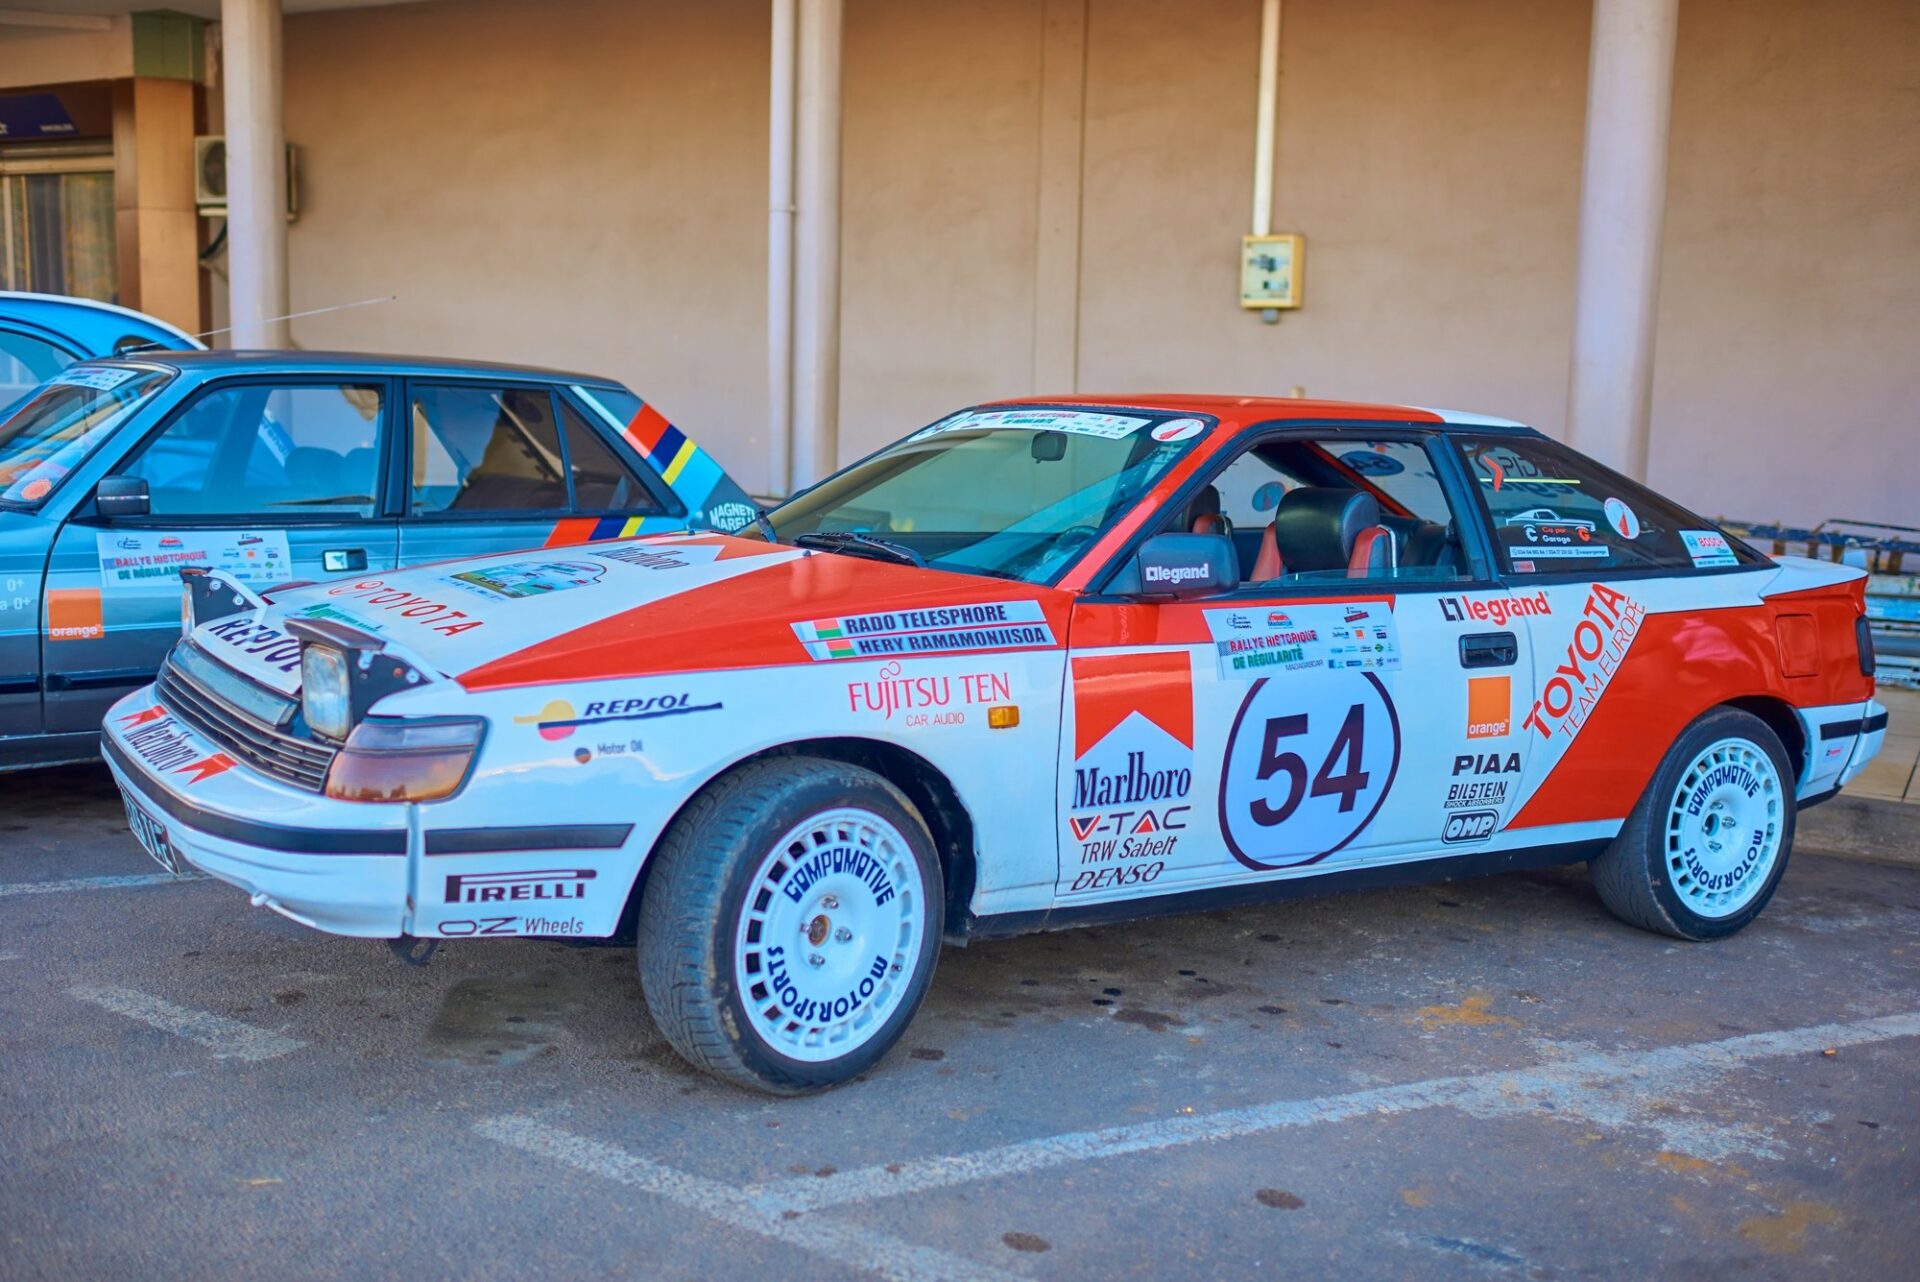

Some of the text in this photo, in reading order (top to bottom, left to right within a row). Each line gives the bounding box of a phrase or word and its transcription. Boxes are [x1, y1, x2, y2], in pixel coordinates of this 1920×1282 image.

[709, 503, 756, 525] MAGNETI
[1542, 535, 1571, 544] Garage
[114, 556, 151, 568] RALLYE
[117, 564, 179, 580] DE RÉGULAR
[1158, 563, 1209, 584] legrand
[353, 588, 484, 636] TOYOTA
[844, 605, 1008, 634] RADO TELESPHORE
[1461, 591, 1553, 626] legrand
[52, 626, 98, 638] orange
[857, 627, 1048, 654] HERY RAMAMONJISOA
[1230, 637, 1265, 653] RALLYE
[1265, 629, 1319, 648] HISTORIQUE
[1233, 643, 1304, 669] DE RÉGULARITÉ
[1522, 582, 1626, 740] TOYOTA
[1558, 596, 1646, 739] TEAM EUROPE
[584, 693, 691, 716] REPSOL
[848, 668, 1012, 720] FUJITSU TEN
[906, 711, 965, 727] CAR AUDIO
[1468, 721, 1506, 736] orange
[122, 717, 199, 771] Marlboro
[1250, 703, 1370, 827] 54
[1451, 752, 1521, 776] PIAA
[1072, 751, 1192, 809] Marlboro
[1447, 781, 1508, 801] BILSTEIN
[1687, 765, 1760, 817] COMPOMOTIVE
[1069, 806, 1192, 841] V-TAC
[1446, 815, 1495, 839] OMP
[1081, 835, 1178, 865] TRW Sabelt
[1684, 830, 1764, 890] MOTORSPORTS
[444, 869, 597, 904] PIRELLI
[783, 848, 895, 907] COMPOMOTIVE
[1070, 861, 1165, 892] DENSO
[525, 916, 584, 935] Wheels
[767, 945, 889, 1023] MOTORSPORTS
